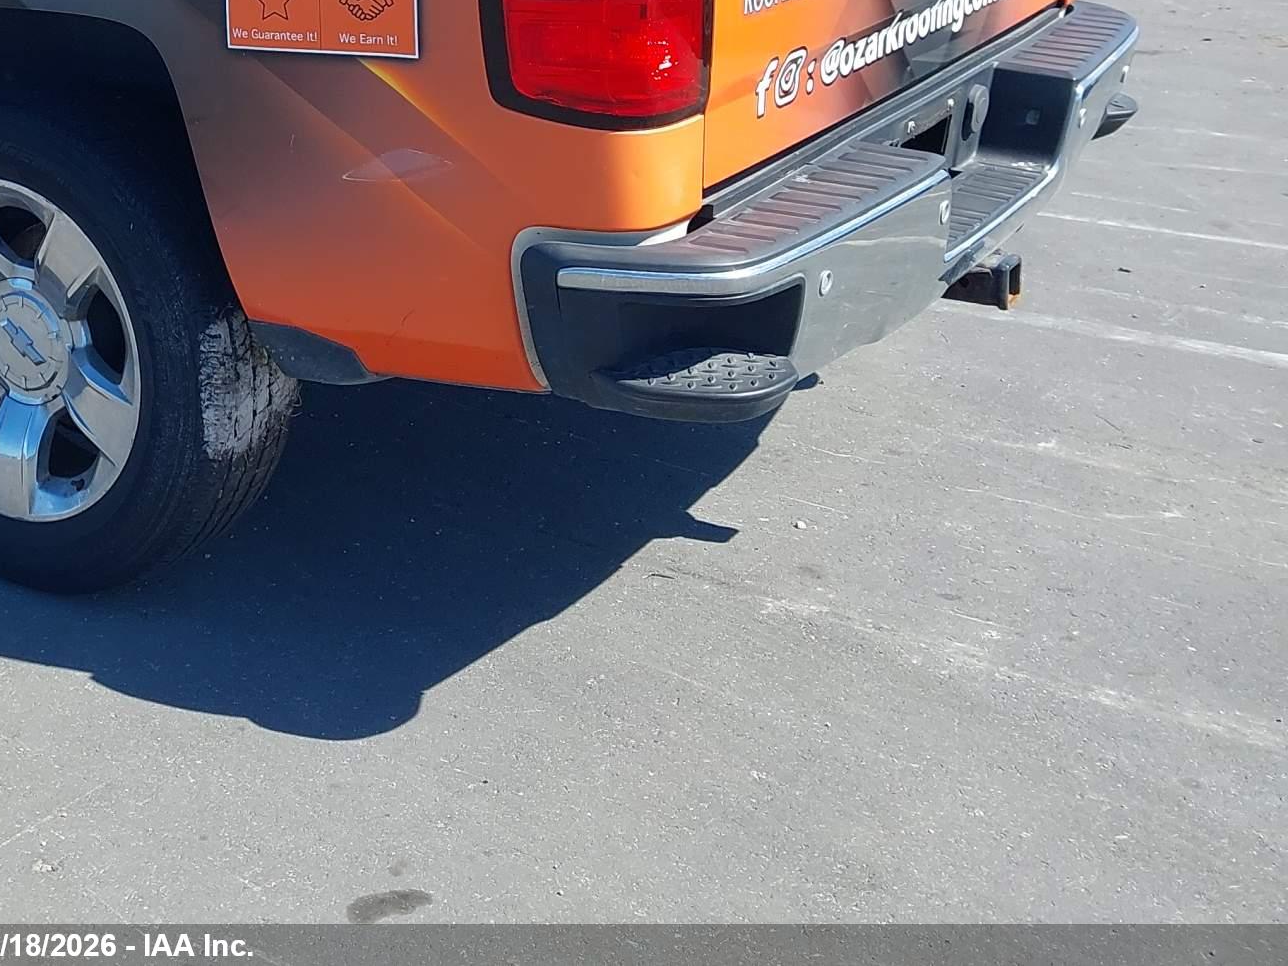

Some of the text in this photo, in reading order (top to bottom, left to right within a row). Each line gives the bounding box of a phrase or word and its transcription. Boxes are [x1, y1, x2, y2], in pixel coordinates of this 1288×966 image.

[232, 27, 318, 42] We Guarantee It!
[339, 33, 398, 45] We Earn It!
